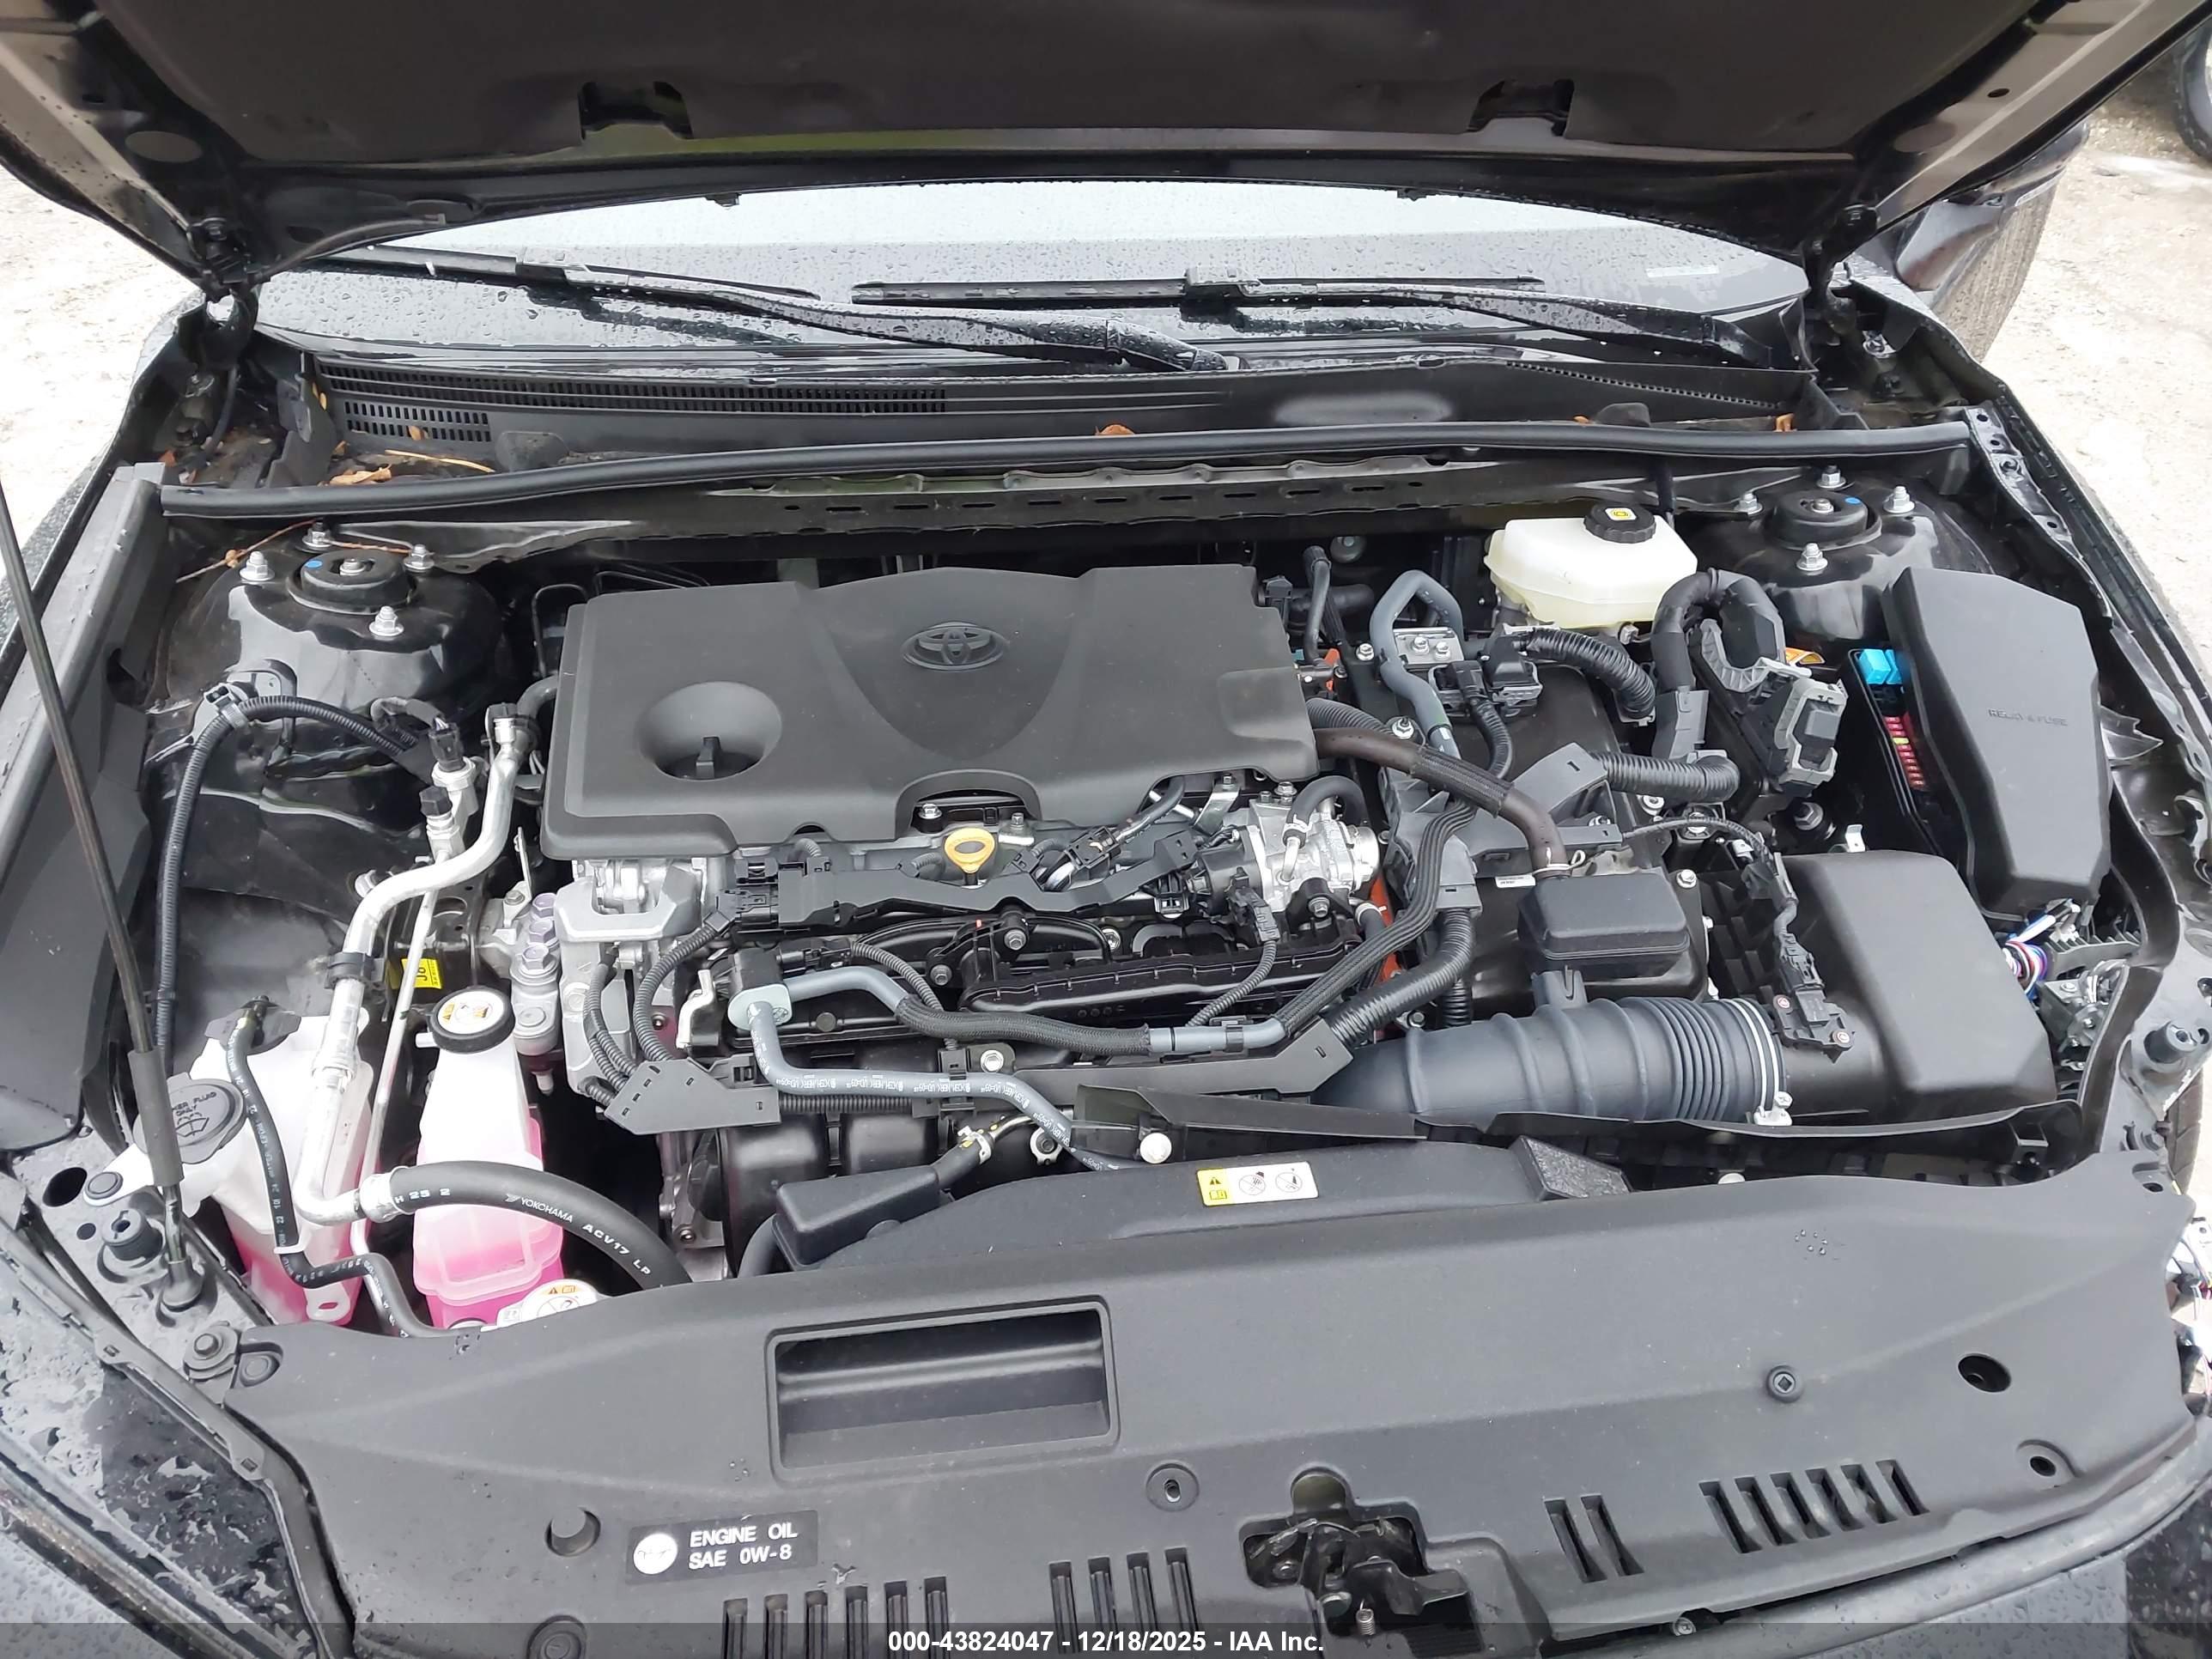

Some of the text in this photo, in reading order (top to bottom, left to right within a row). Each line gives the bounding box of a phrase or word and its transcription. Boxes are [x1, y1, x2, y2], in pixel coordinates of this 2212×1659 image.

[409, 1189, 430, 1200] 25
[440, 1188, 451, 1196] 2
[520, 1197, 652, 1276] YOKOHAMA ACV17 LP
[690, 1522, 798, 1547] ENGINE OIL
[689, 1544, 793, 1570] SAE 0W-8
